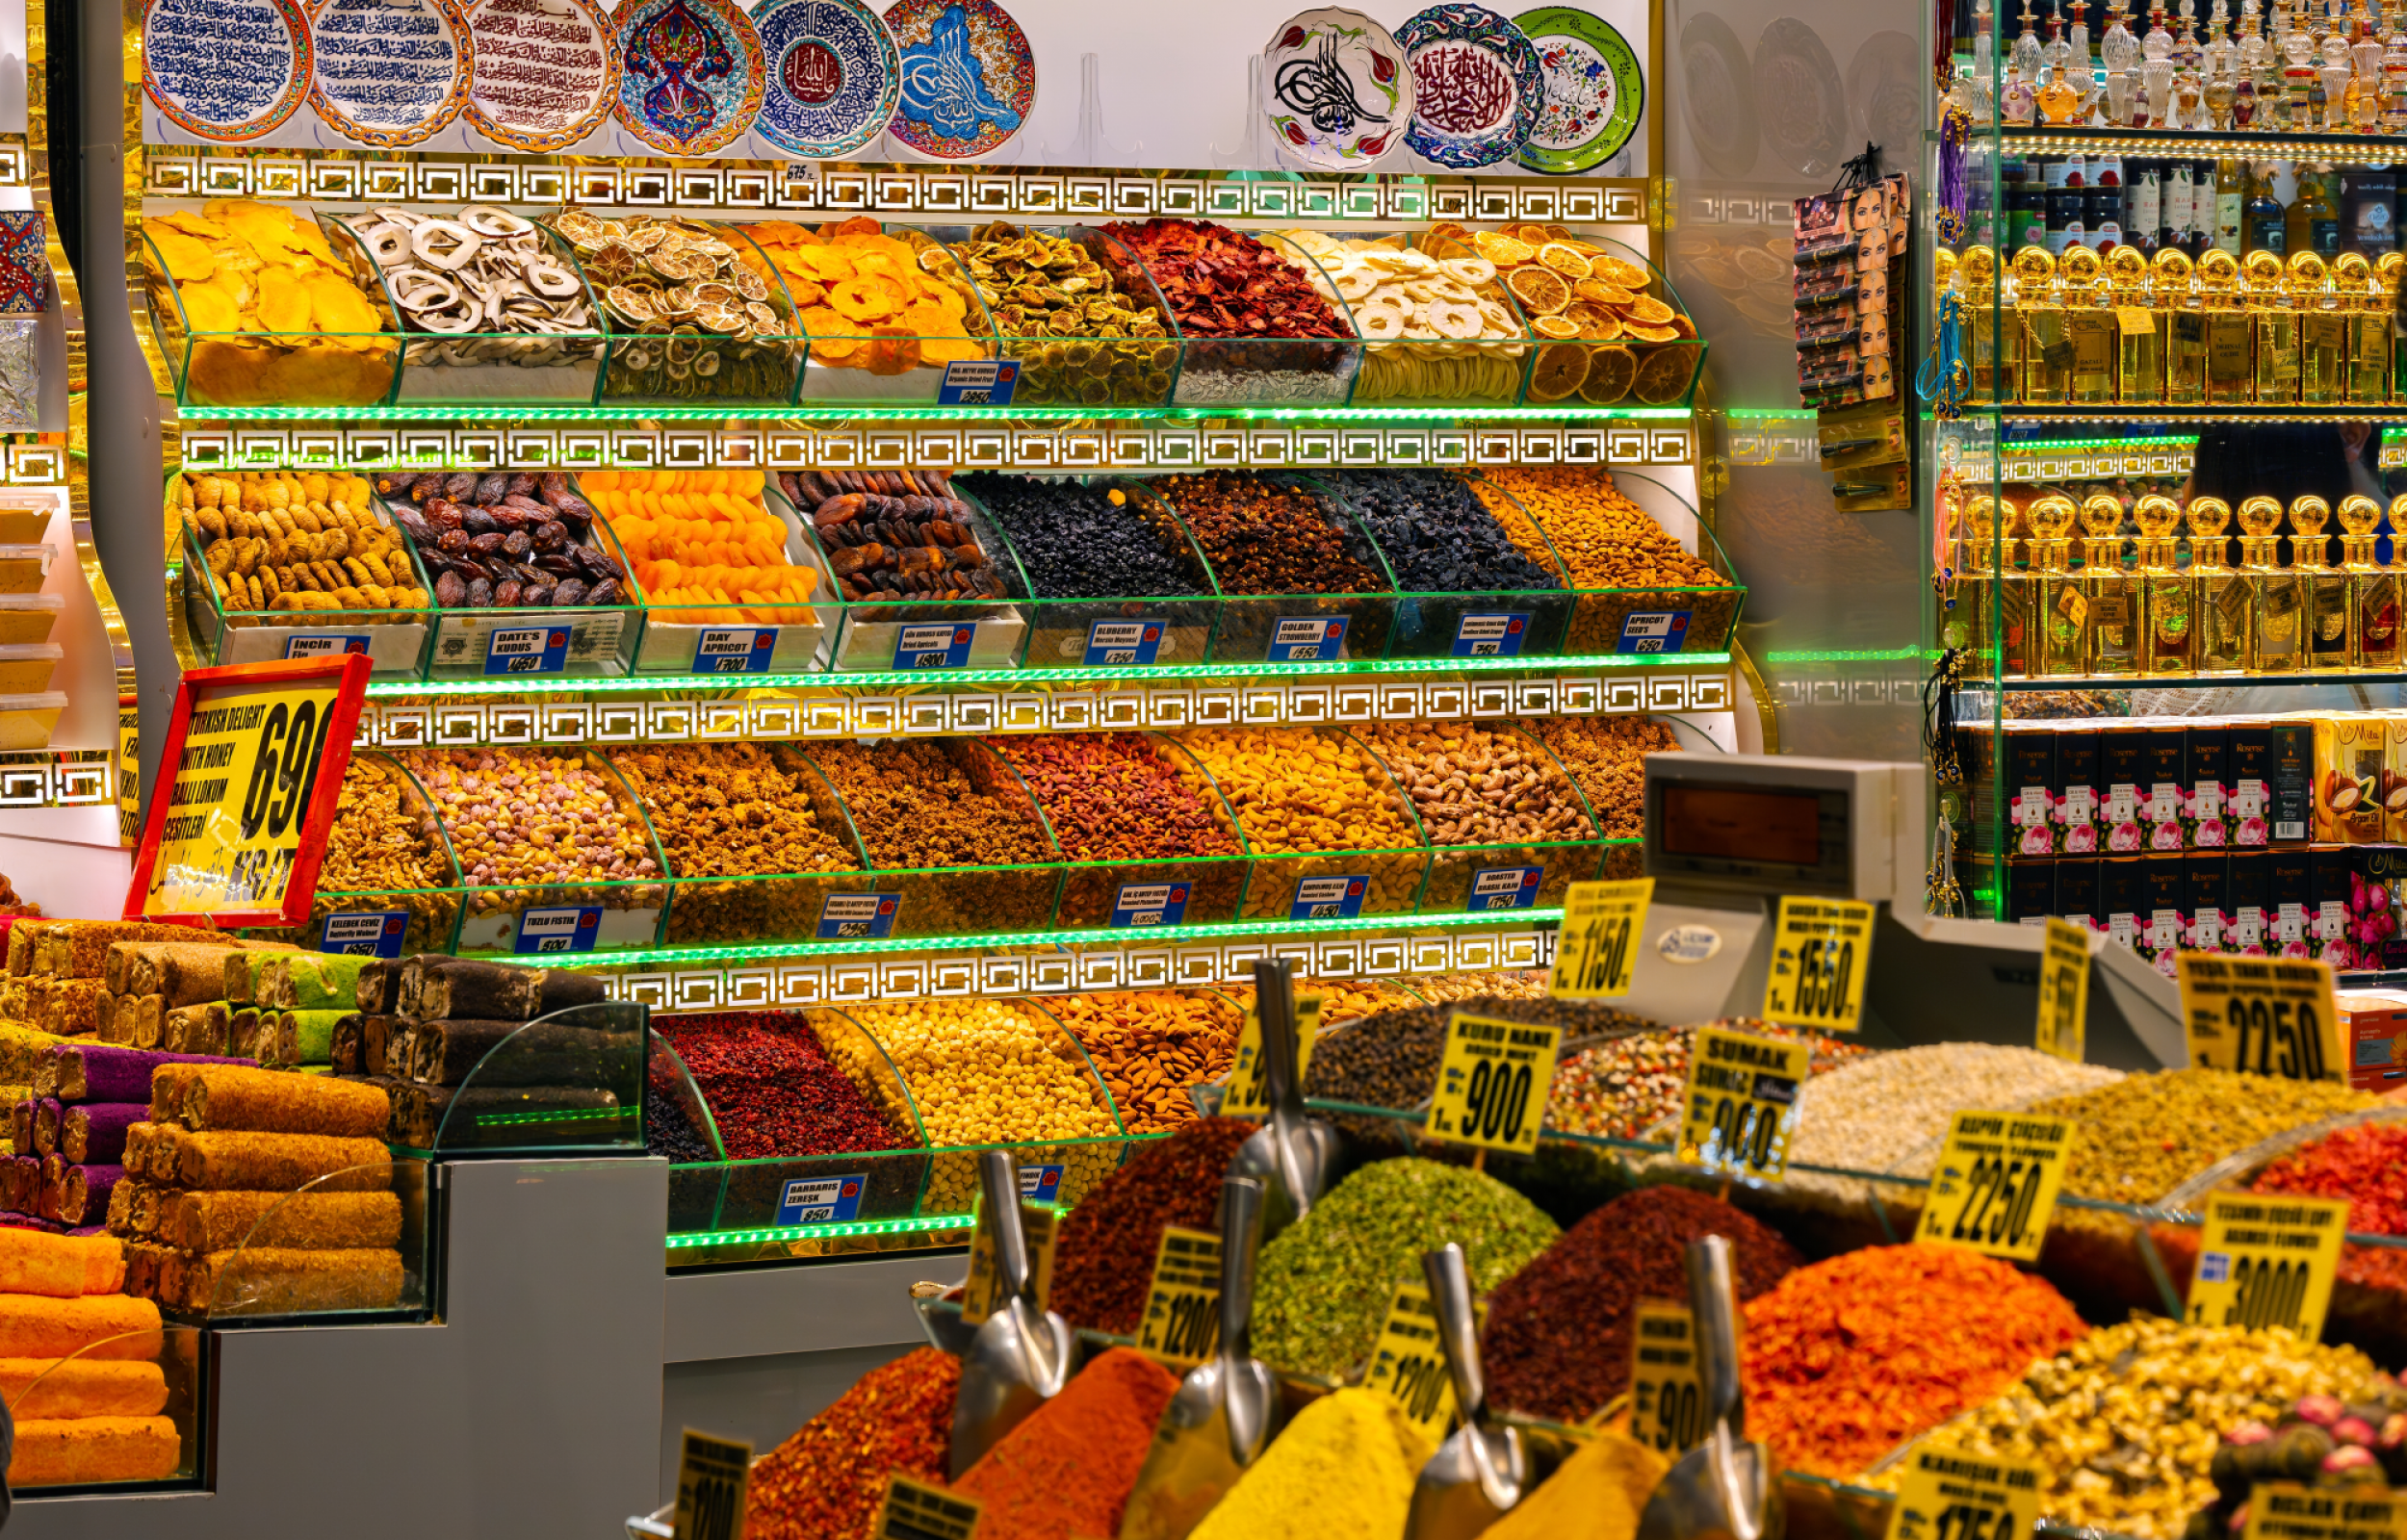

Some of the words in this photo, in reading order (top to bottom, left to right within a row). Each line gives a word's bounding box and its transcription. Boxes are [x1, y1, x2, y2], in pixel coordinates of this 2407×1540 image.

[1629, 616, 1666, 625] APRICOT
[1096, 627, 1138, 635] BLUBERRY
[1281, 623, 1314, 631] GOLDEN
[498, 631, 540, 642] DATE'S
[707, 632, 732, 642] DAY
[294, 639, 332, 650] İNCİR
[496, 642, 531, 653] KUDUS
[704, 642, 748, 653] APRICOT
[189, 708, 227, 736] TURKISH
[225, 704, 267, 732] DELIGHT
[2237, 742, 2265, 753] Rosense
[180, 744, 204, 772] WITH
[203, 741, 237, 769] HONEY
[170, 781, 195, 807] BALLI
[194, 778, 229, 805] LOKUM
[162, 810, 208, 847] ÇEŞİTLERİ
[360, 916, 380, 927] CEVİZ
[527, 916, 550, 926] TUZLU
[550, 915, 576, 925] FISTIK
[1457, 1020, 1507, 1043] KURU
[1507, 1026, 1553, 1049] NANE
[2229, 997, 2325, 1080] 2250
[1706, 1039, 1791, 1072] SUMAK
[1460, 1059, 1533, 1143] 900
[789, 1182, 839, 1194] BARBARIS
[787, 1194, 820, 1204] ZEREŞK
[1952, 1157, 2044, 1248] 2250
